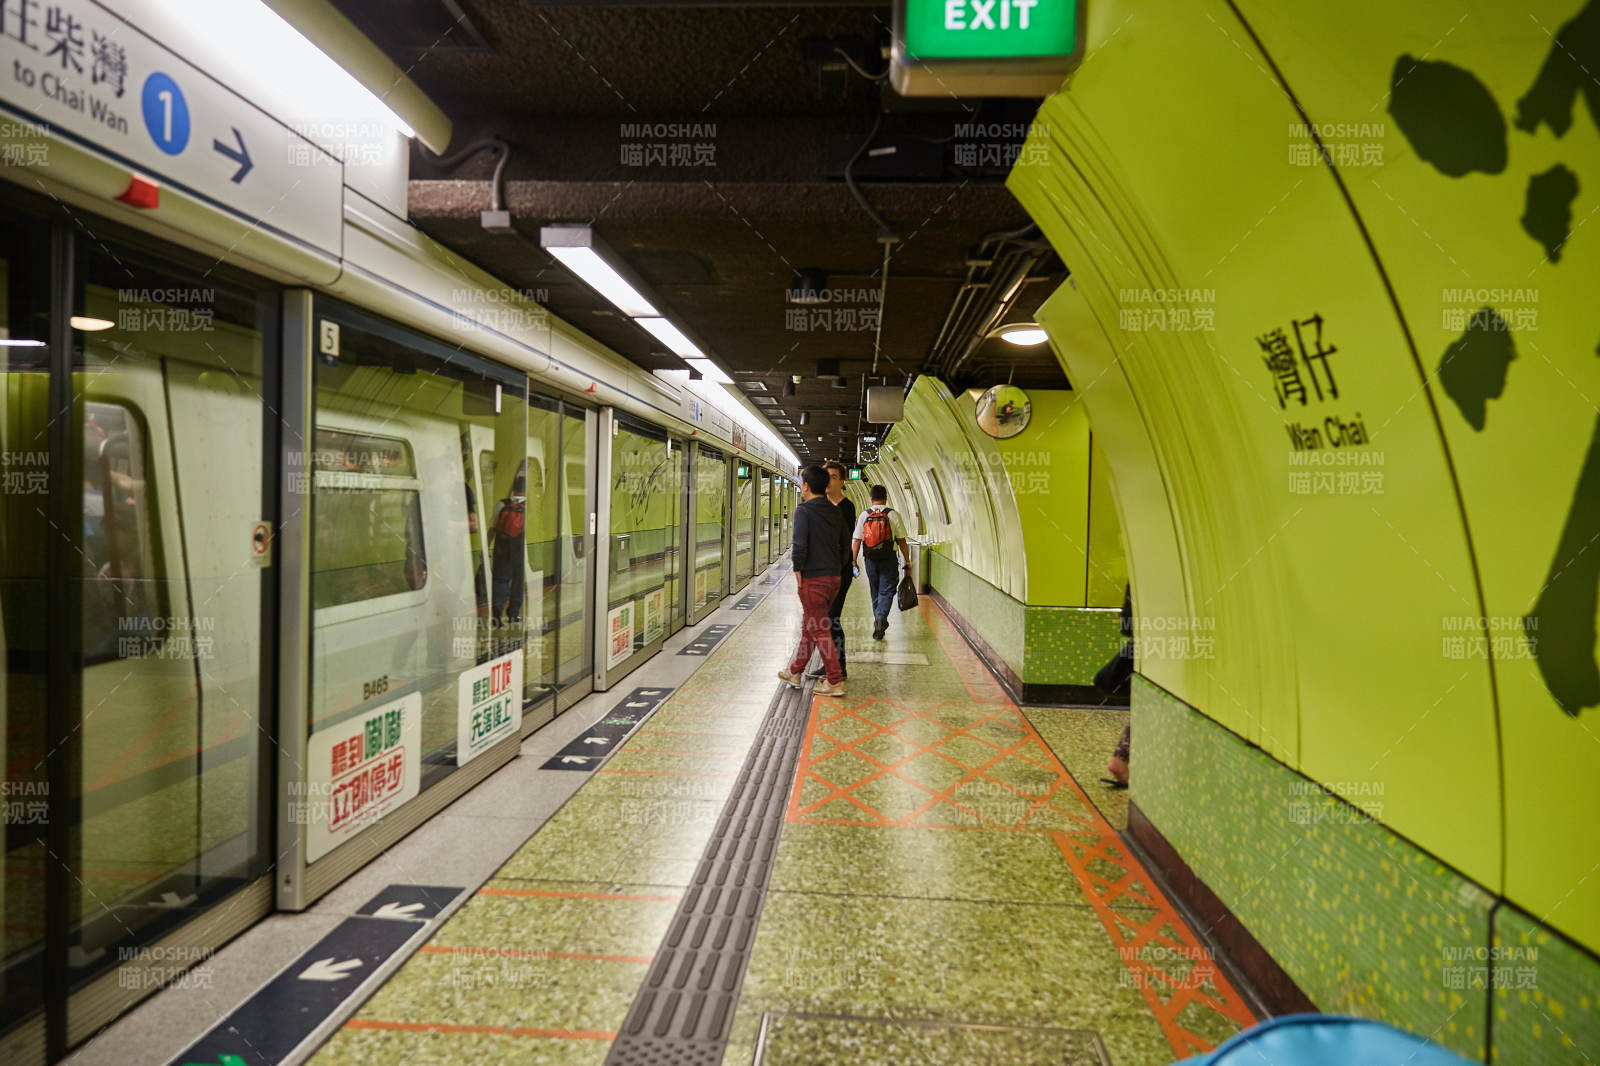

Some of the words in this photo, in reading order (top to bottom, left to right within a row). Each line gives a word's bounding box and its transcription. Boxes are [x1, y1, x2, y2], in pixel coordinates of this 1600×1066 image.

[944, 0, 1038, 30] EXIT
[13, 59, 36, 88] to
[41, 71, 85, 114] Chai
[89, 94, 128, 135] Wan
[158, 90, 172, 142] 1
[326, 327, 335, 350] 5
[1255, 312, 1338, 410] 灣仔
[1285, 422, 1324, 451] Wan
[1324, 412, 1369, 448] Chai
[363, 675, 388, 701] B465
[332, 753, 403, 826] 立即停步
